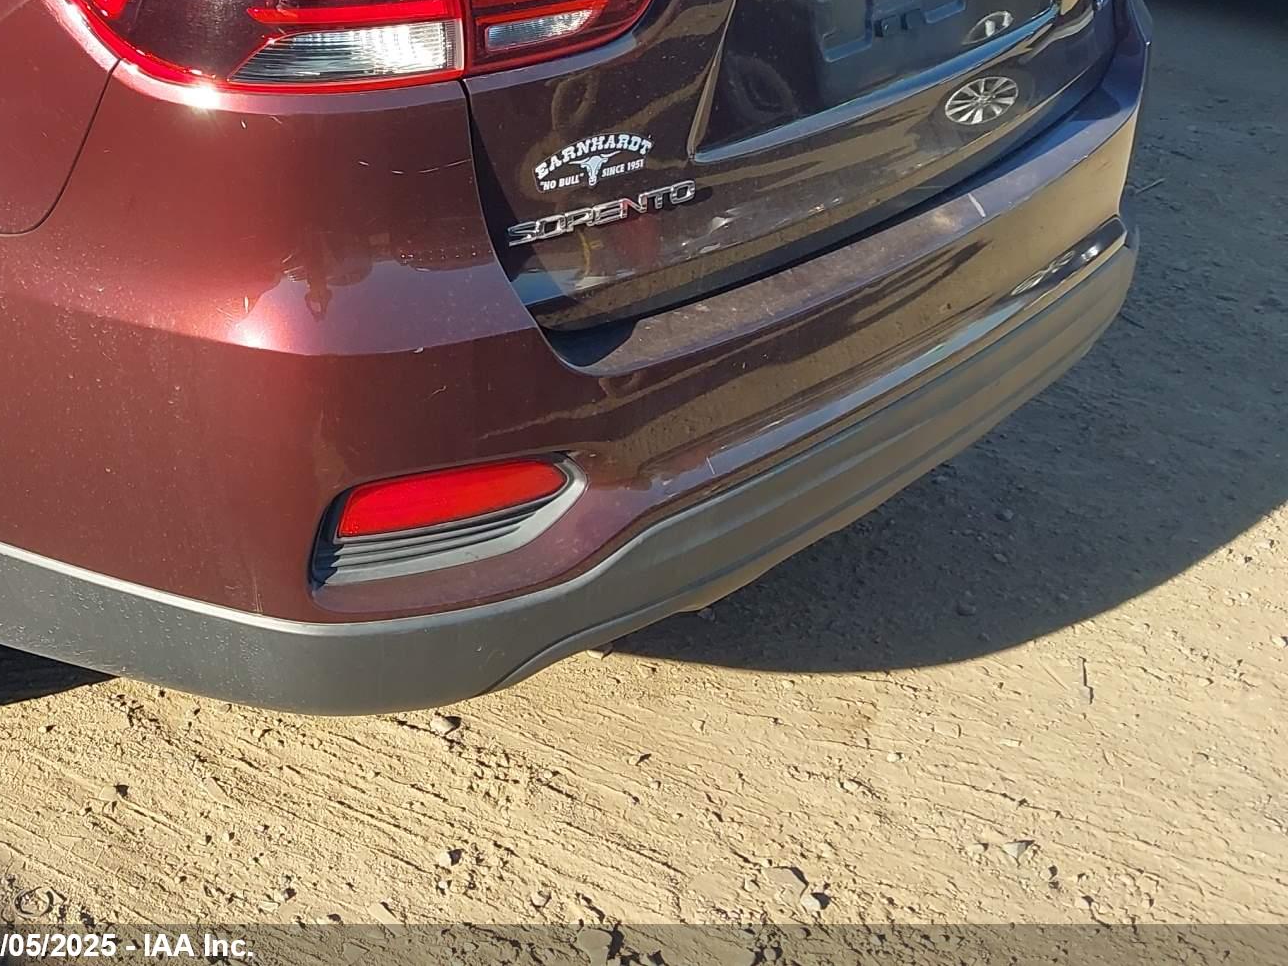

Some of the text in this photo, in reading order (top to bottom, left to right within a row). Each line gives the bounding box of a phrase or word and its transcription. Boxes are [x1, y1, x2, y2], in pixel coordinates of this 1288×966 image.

[535, 134, 652, 179] EARNHARDT
[602, 163, 625, 177] SINCE
[507, 180, 696, 247] SORENTO
